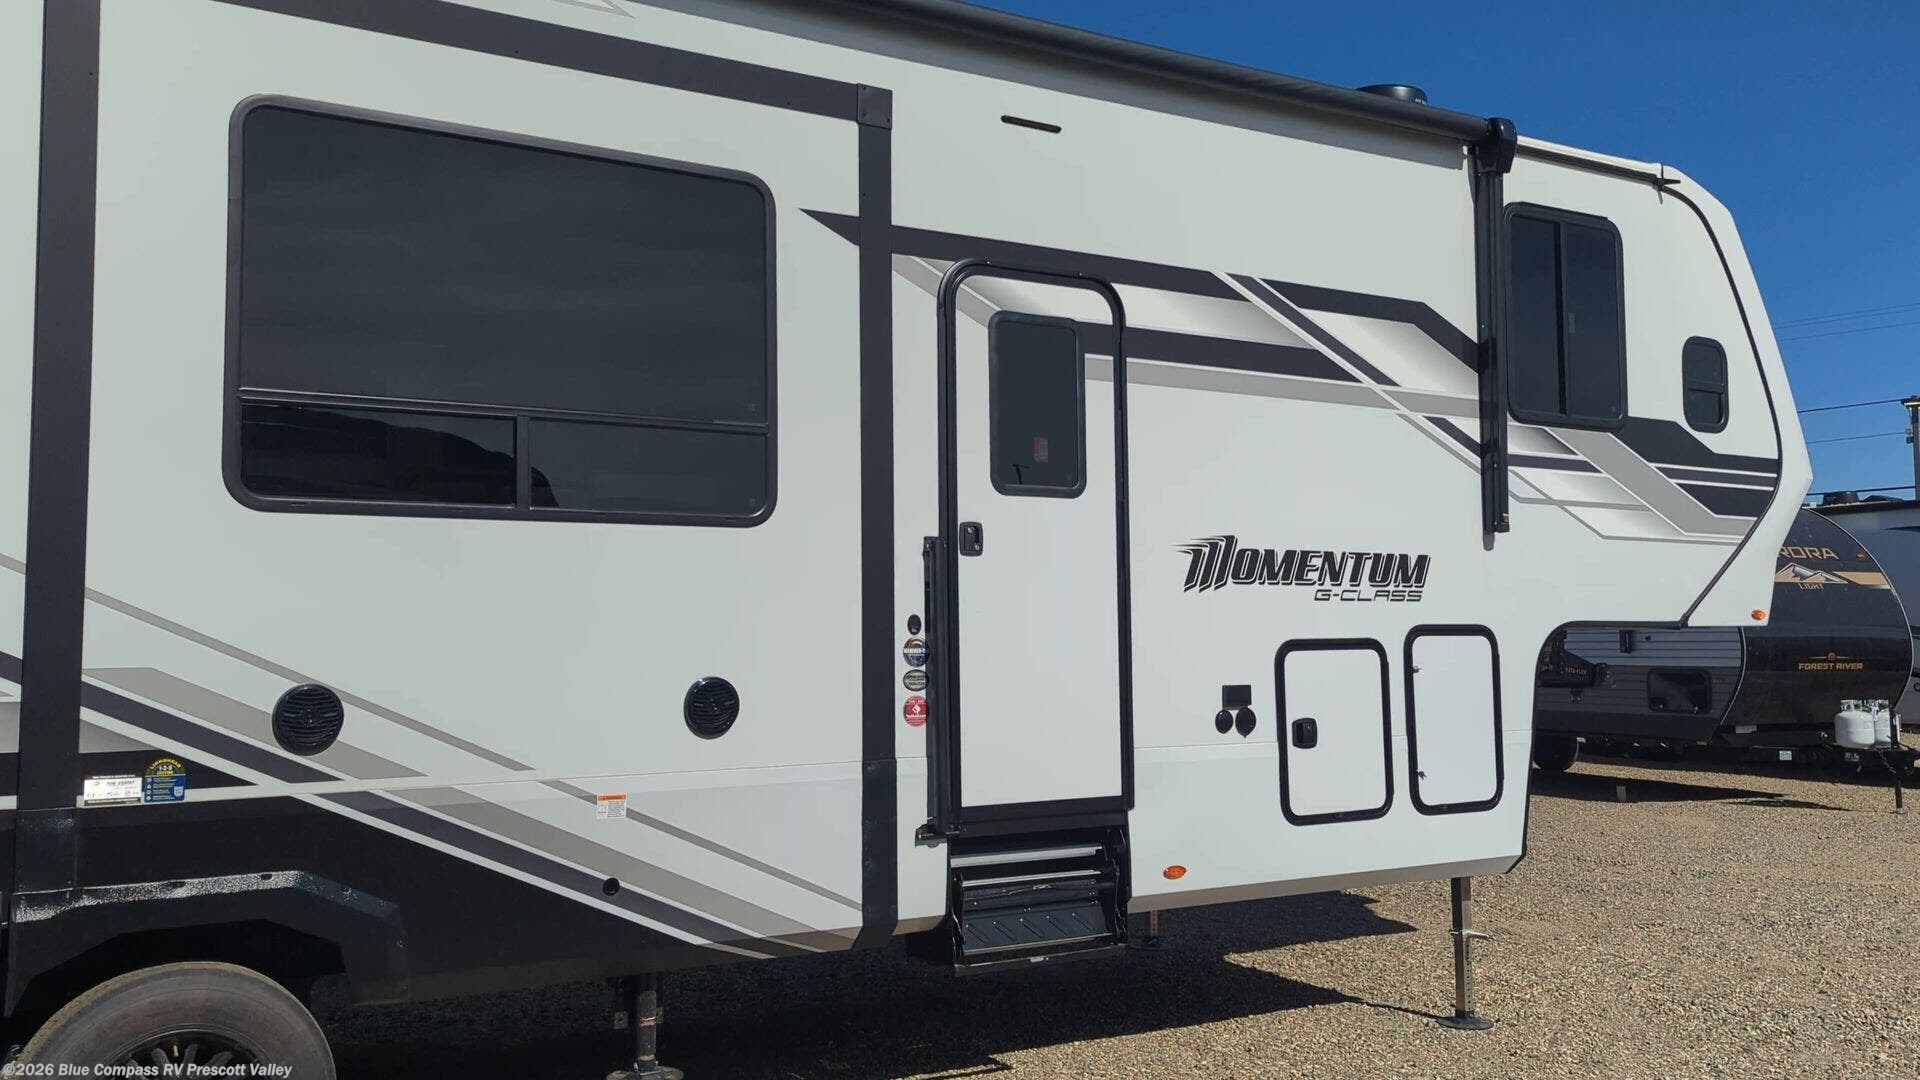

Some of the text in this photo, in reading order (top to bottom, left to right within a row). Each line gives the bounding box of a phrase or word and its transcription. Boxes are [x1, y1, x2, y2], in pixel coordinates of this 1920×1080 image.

[1172, 535, 1431, 592] MOMENTUM
[1314, 589, 1423, 602] G-CLASS
[1798, 662, 1863, 671] FOREST RIVER
